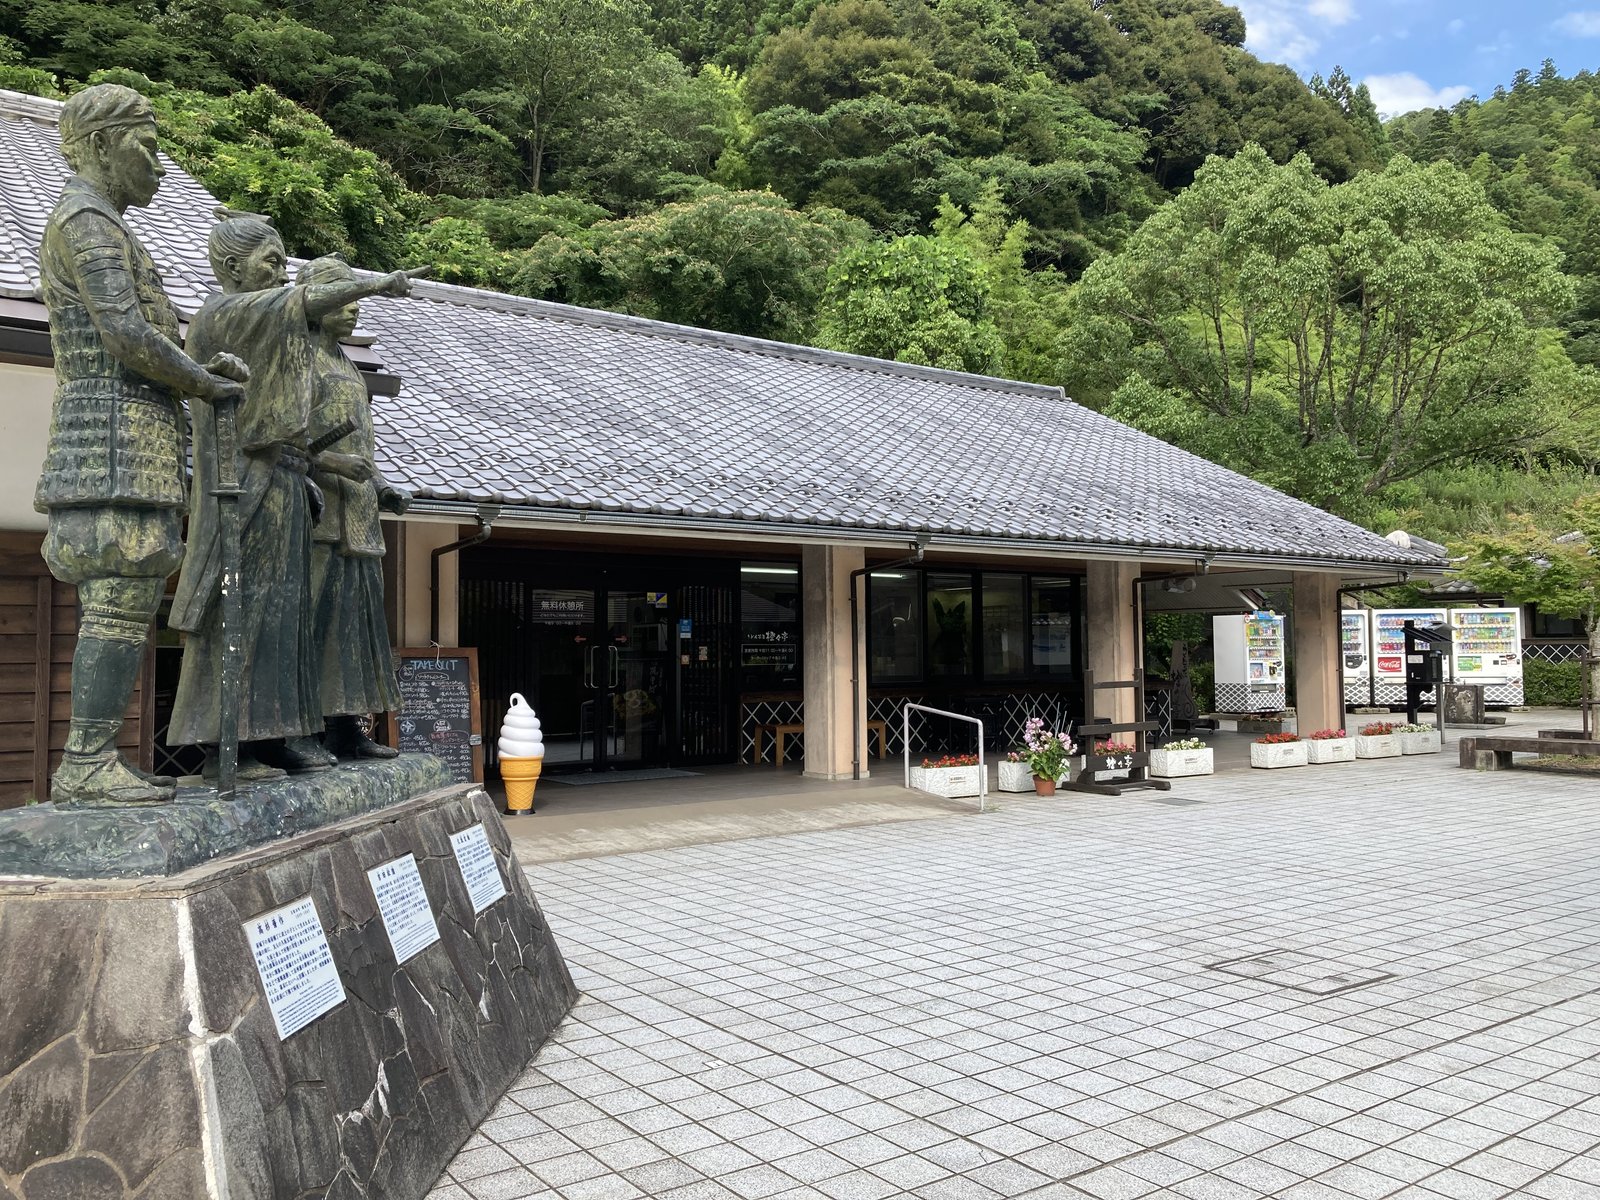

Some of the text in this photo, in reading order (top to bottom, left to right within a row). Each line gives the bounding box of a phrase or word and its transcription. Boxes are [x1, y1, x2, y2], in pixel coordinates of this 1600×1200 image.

[541, 600, 584, 611] 無料休憩所
